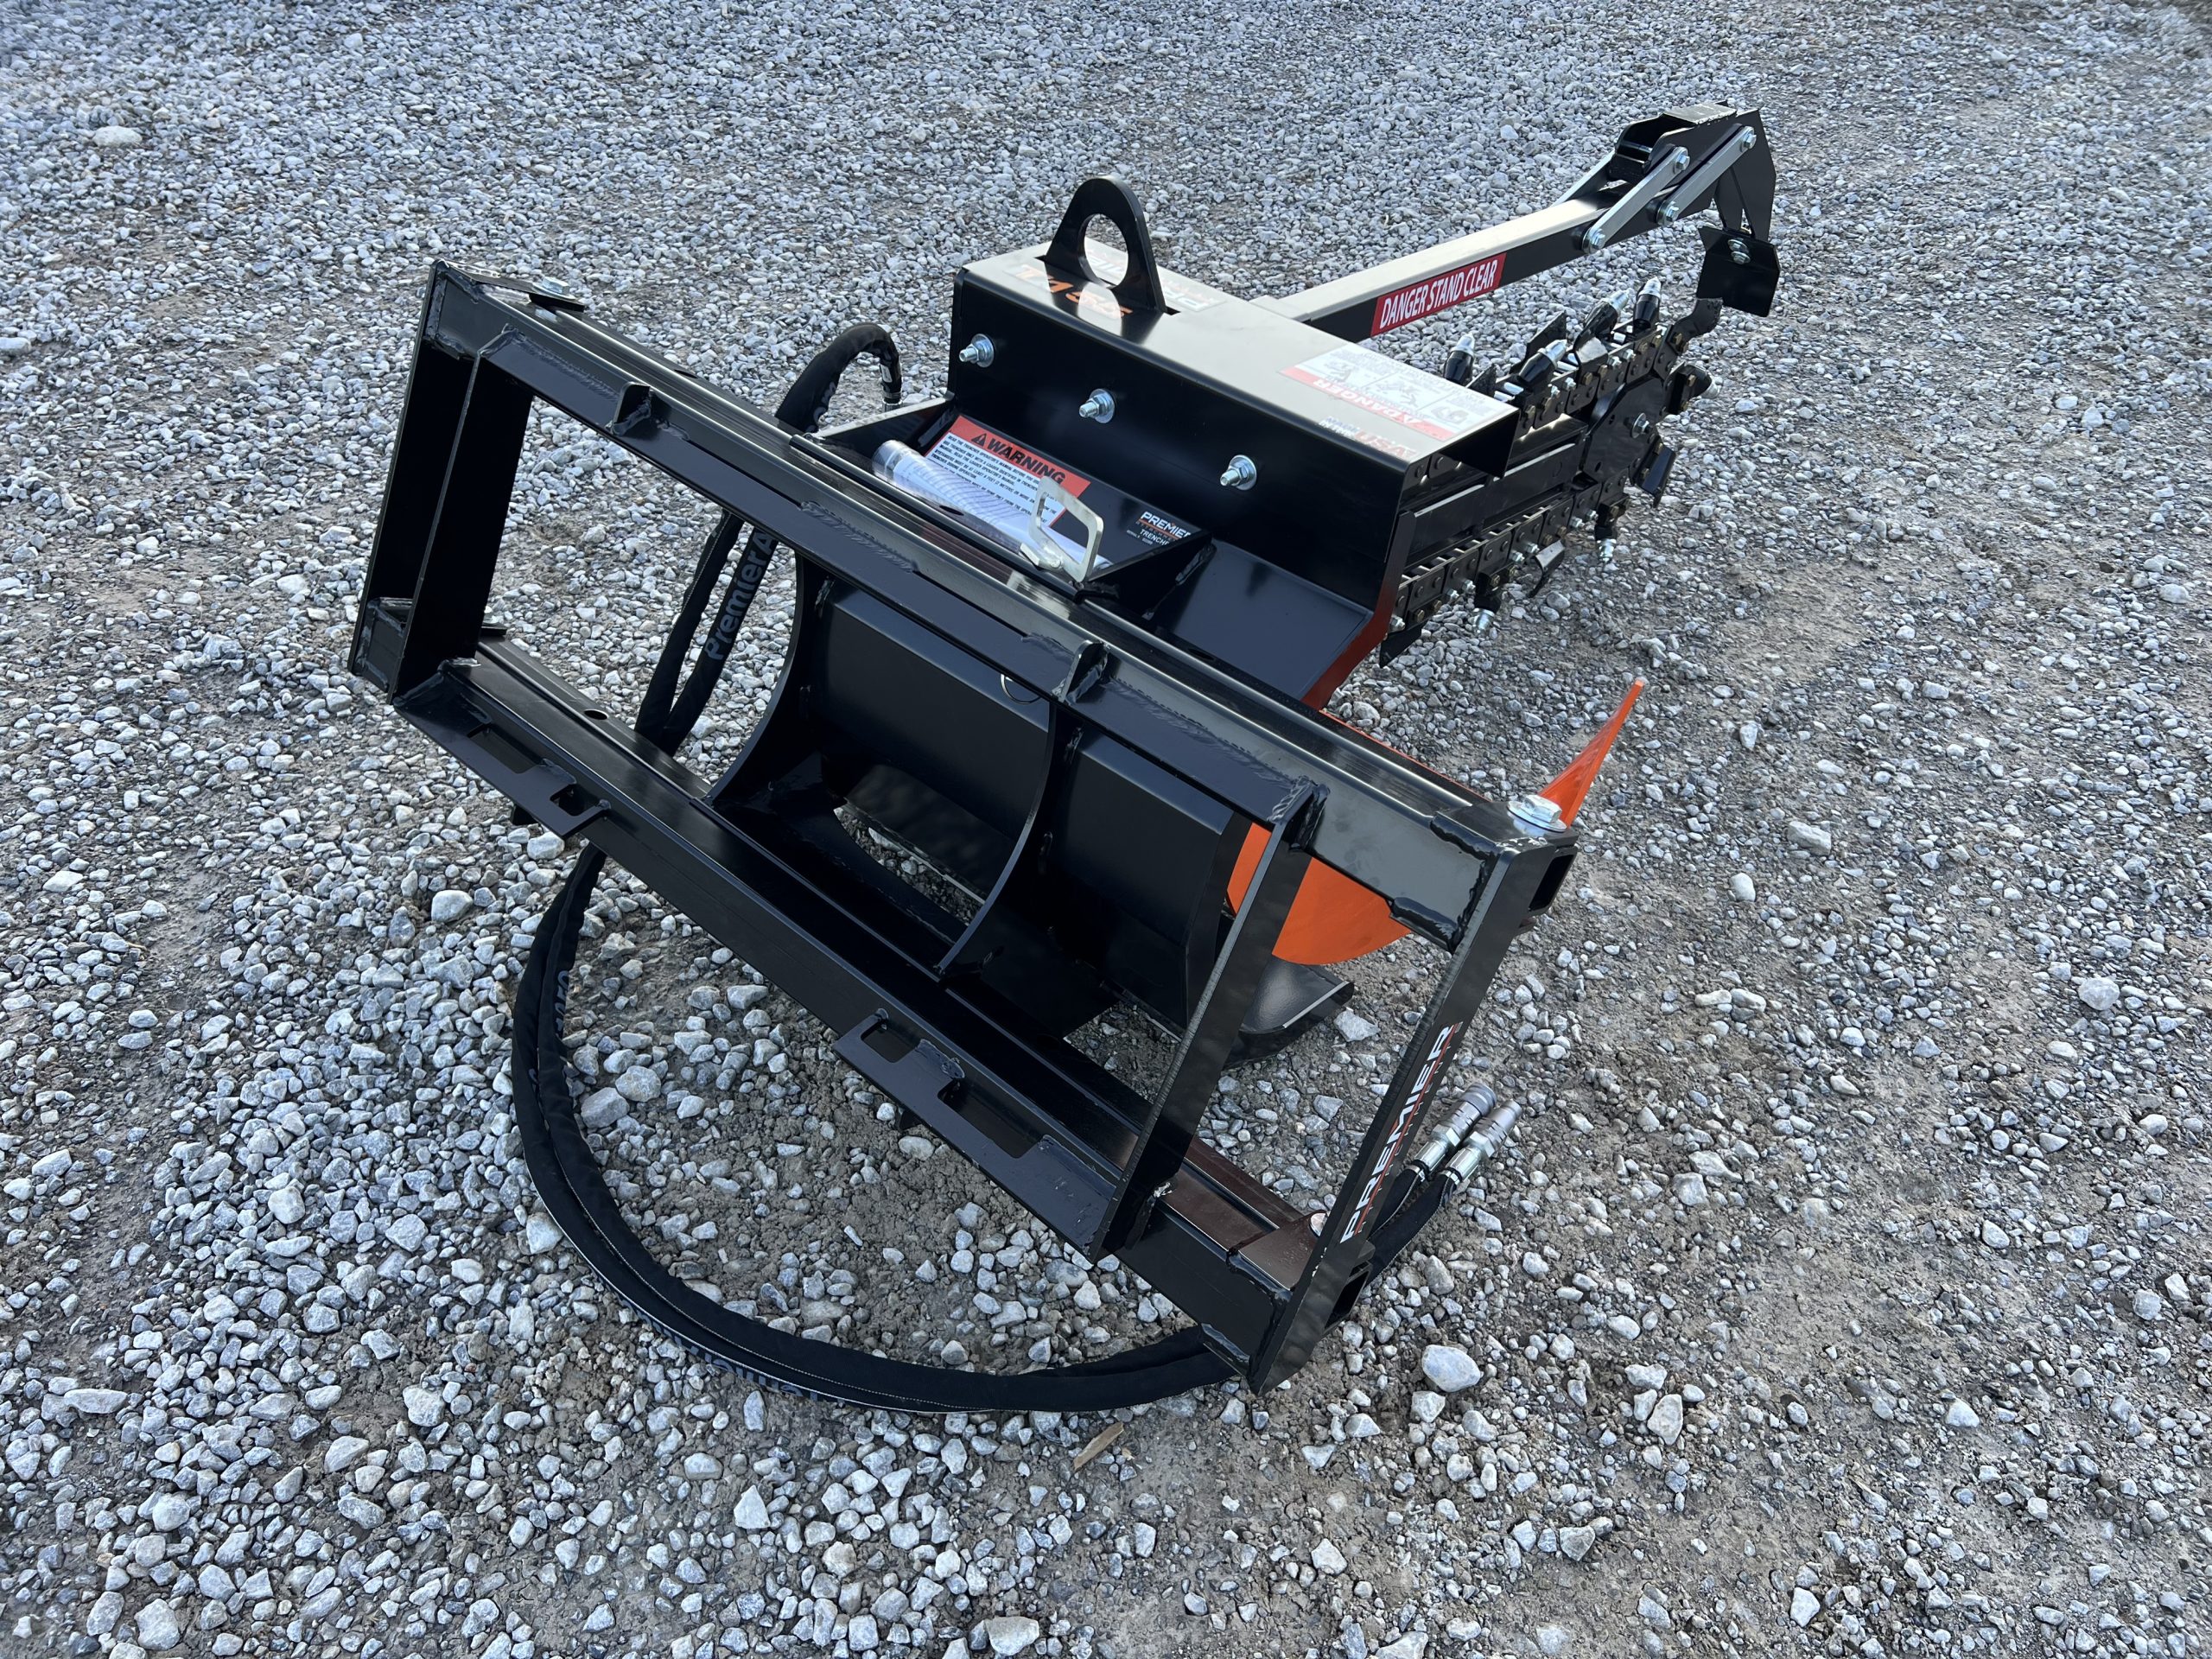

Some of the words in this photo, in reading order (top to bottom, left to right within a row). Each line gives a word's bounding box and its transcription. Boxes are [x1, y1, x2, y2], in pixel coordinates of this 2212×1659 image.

[1380, 284, 1428, 330] DANGER
[1427, 271, 1465, 312] STAND
[1463, 259, 1498, 297] CLEAR
[1313, 379, 1403, 418] DANGER
[987, 438, 1065, 485] WARNING
[1340, 1025, 1454, 1244] PREMIER
